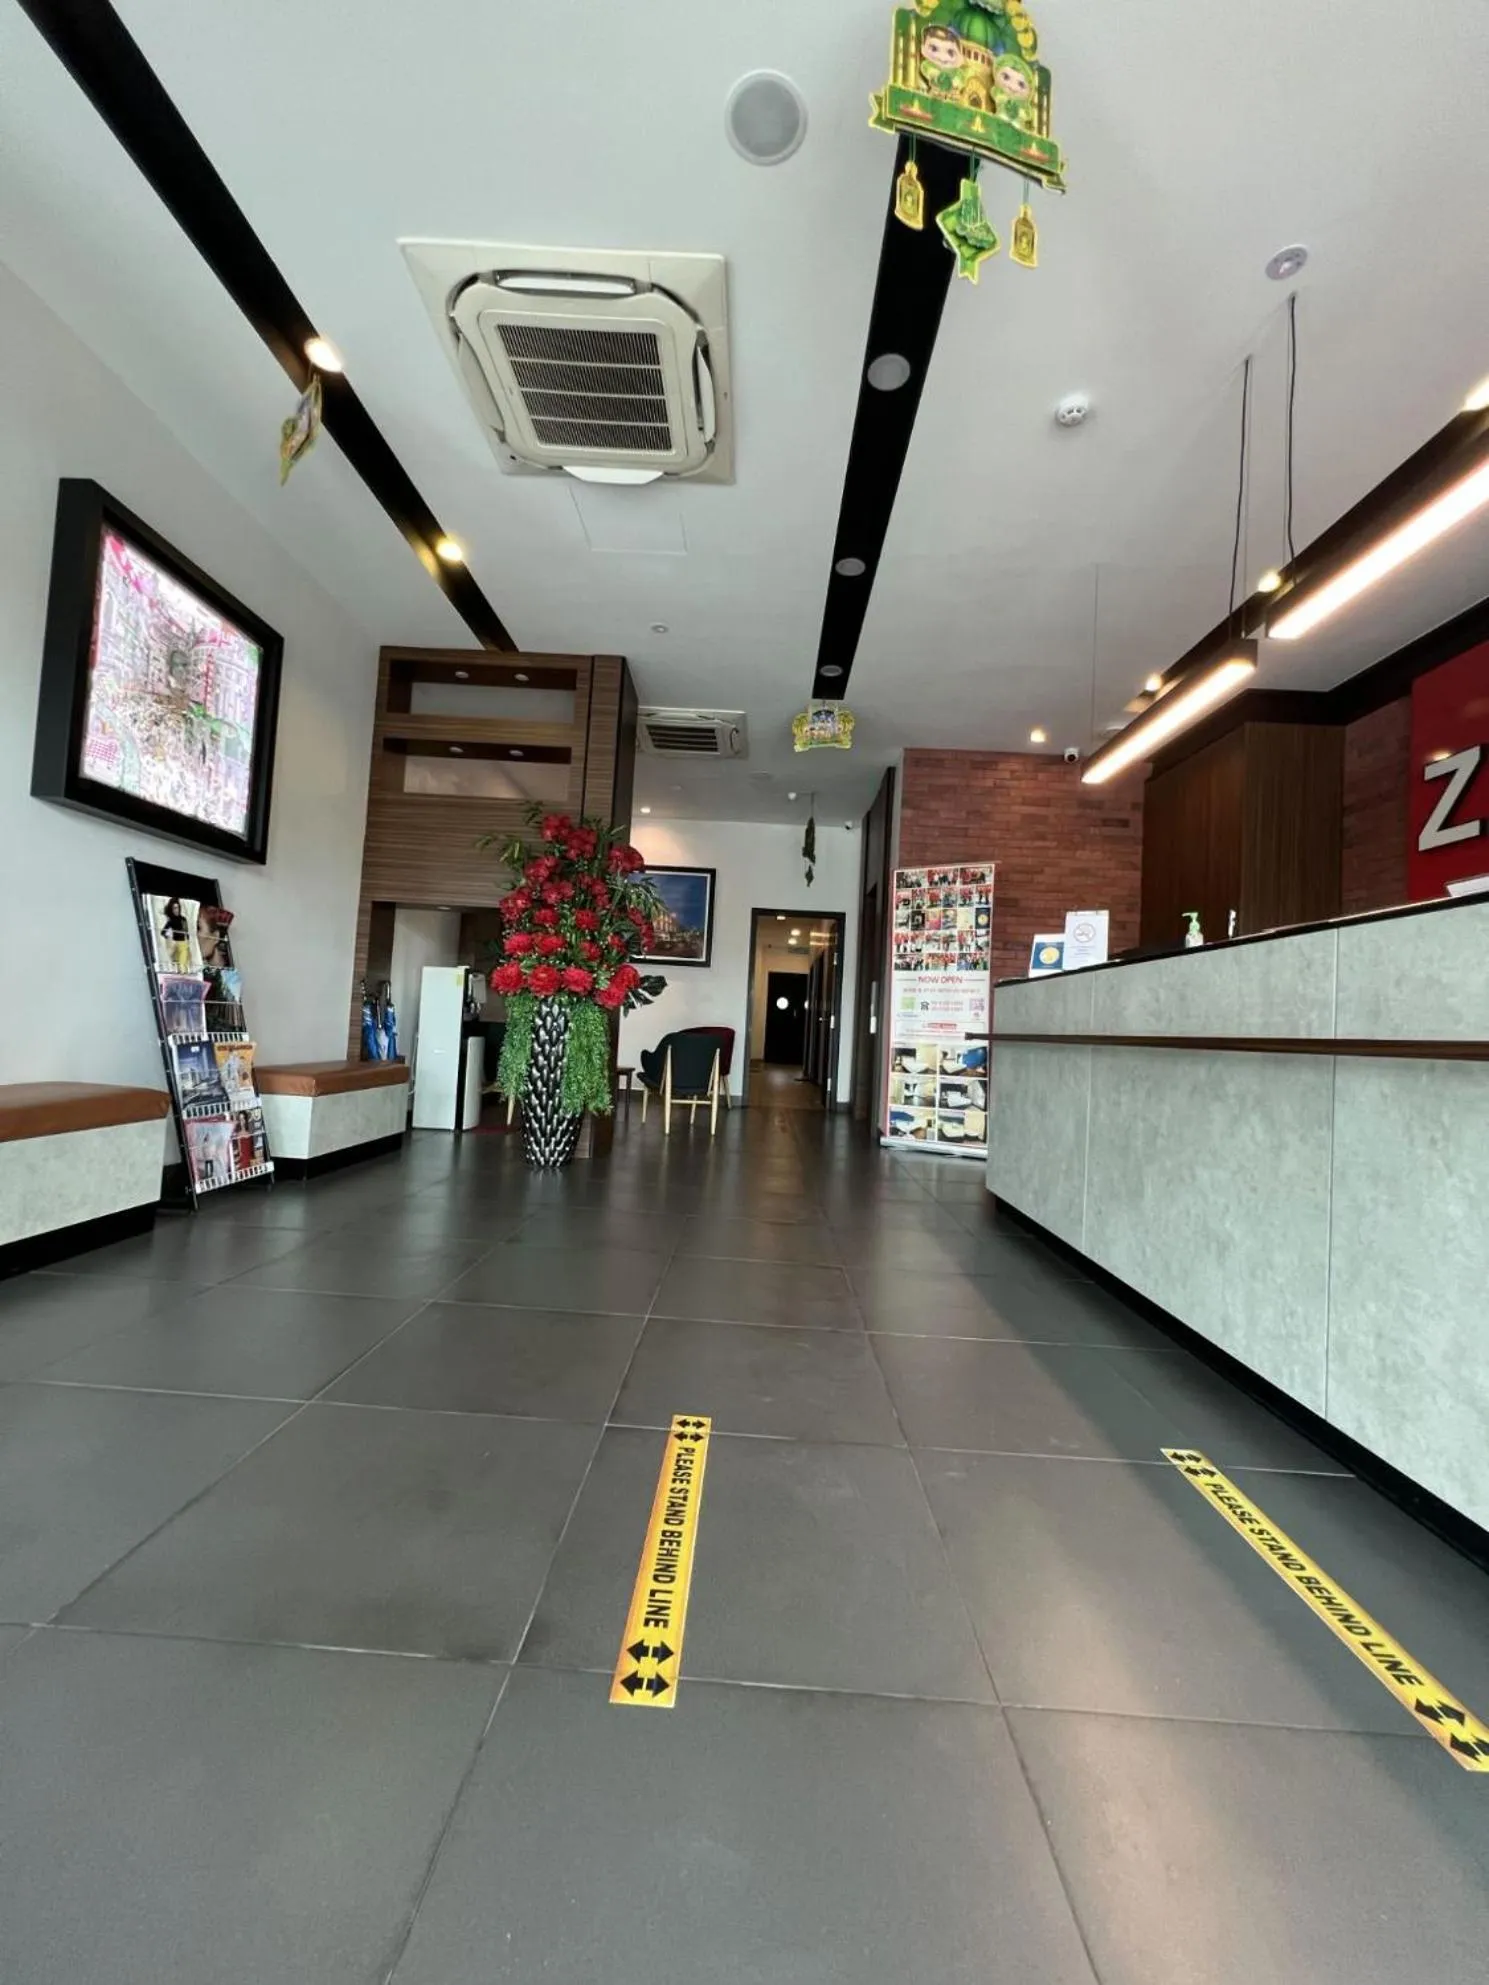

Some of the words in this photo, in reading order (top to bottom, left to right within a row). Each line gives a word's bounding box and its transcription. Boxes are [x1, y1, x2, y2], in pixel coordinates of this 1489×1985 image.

[940, 976, 963, 984] OPEN
[671, 1446, 696, 1485] PLEASE
[664, 1486, 689, 1527] STAND
[653, 1529, 683, 1584] BEHIND
[1204, 1482, 1261, 1525] PLEASE
[1249, 1527, 1307, 1572] STAND
[1296, 1575, 1371, 1637] BEHIND
[1359, 1640, 1425, 1687] LINE
[643, 1589, 673, 1629] LINE
